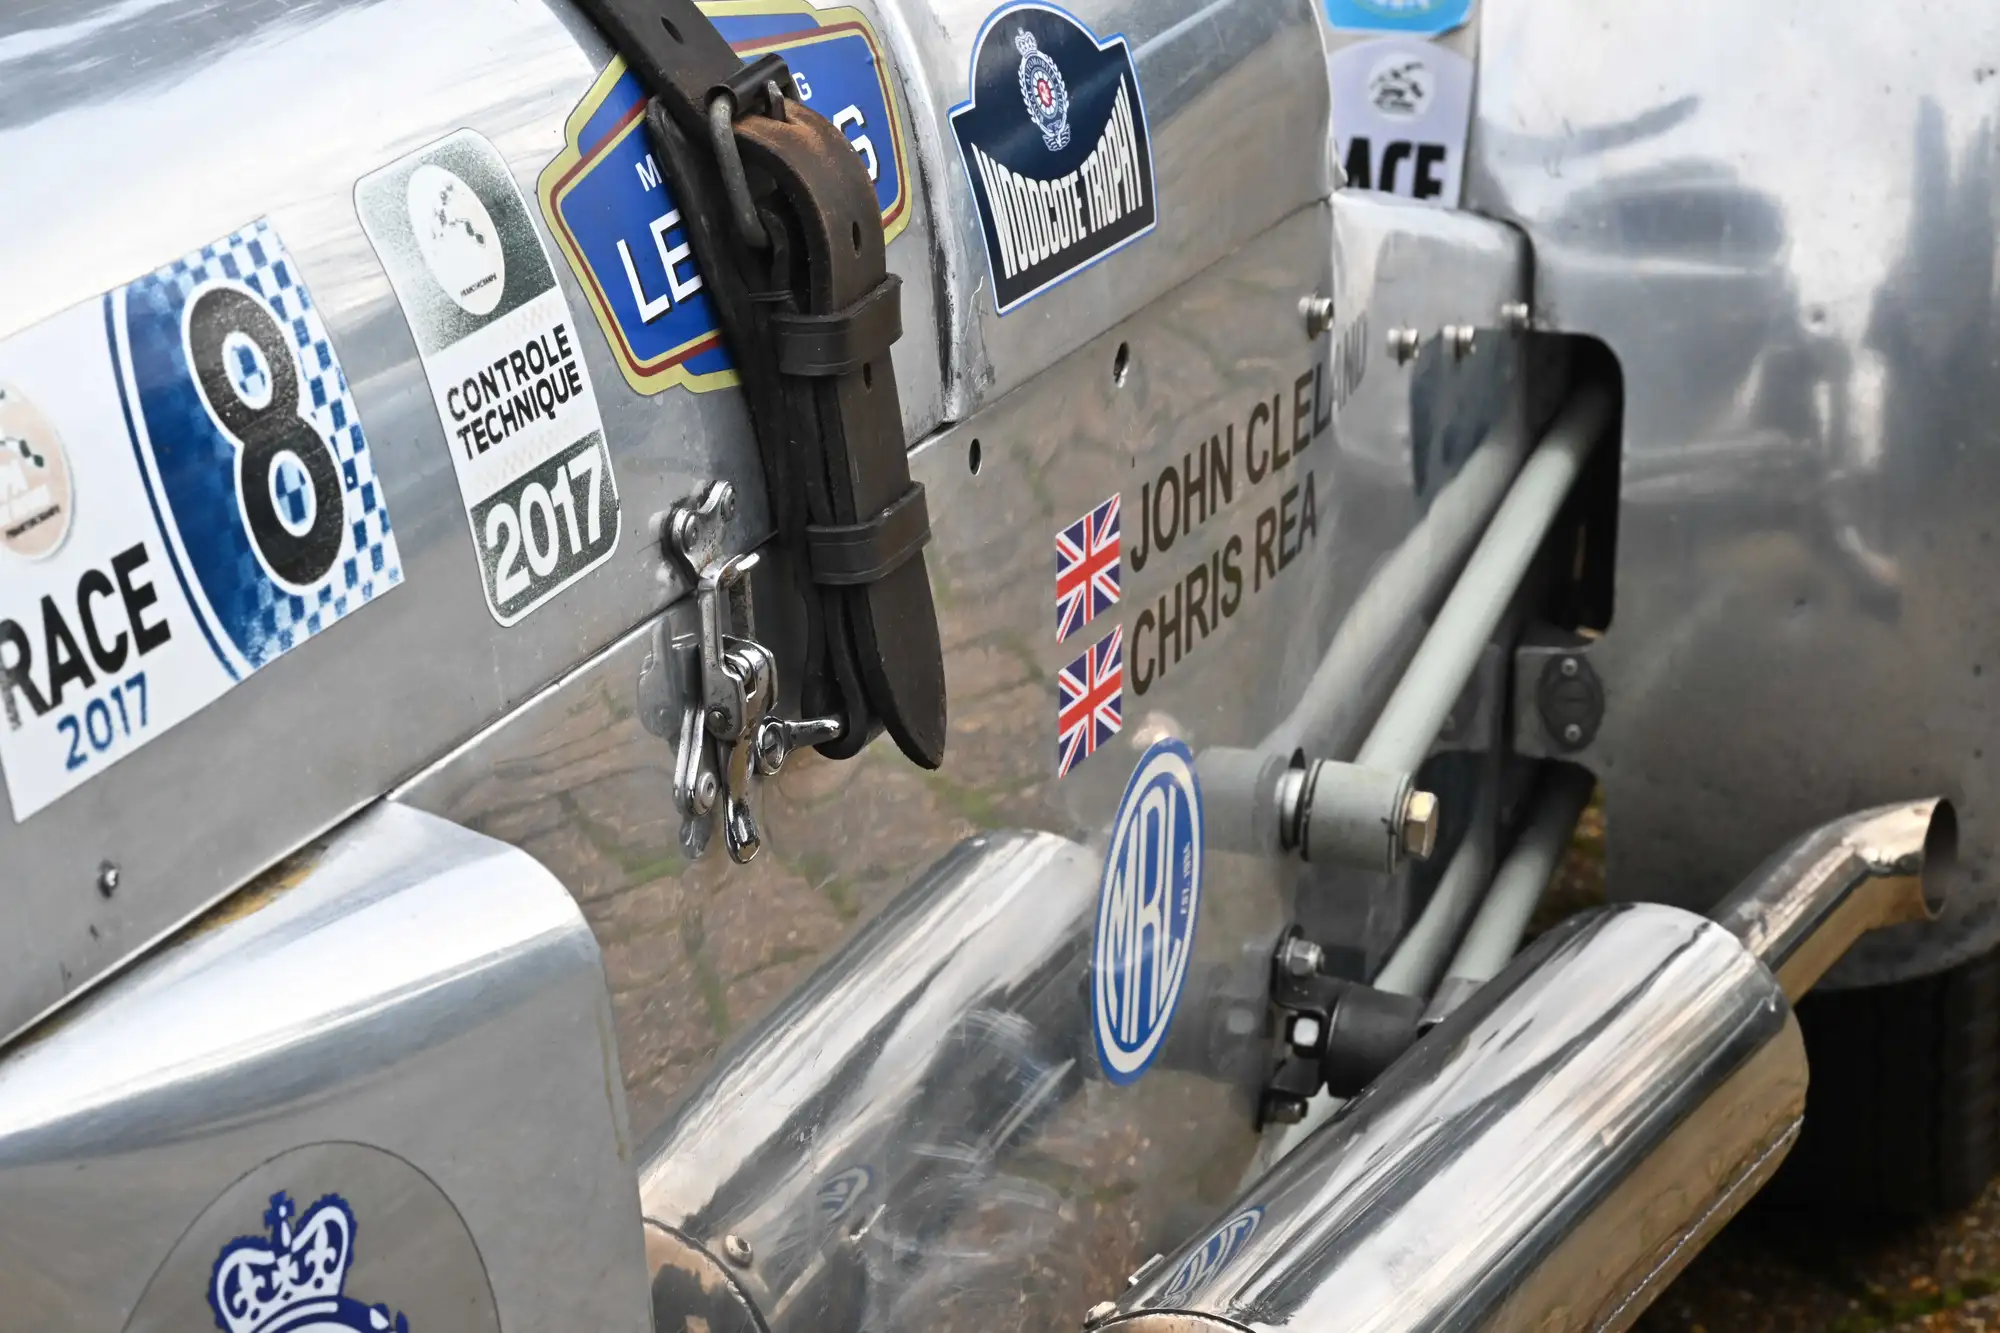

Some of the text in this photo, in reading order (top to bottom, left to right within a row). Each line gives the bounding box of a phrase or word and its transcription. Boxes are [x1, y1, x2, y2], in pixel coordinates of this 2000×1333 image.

[971, 72, 1142, 279] WOODCOTE TROPHY
[187, 285, 345, 588] 8
[446, 323, 572, 423] CONTROLE
[457, 360, 583, 460] TECHNIQUE
[486, 444, 602, 600] 2017
[1130, 424, 1234, 573] JOHN
[1130, 470, 1317, 696] CHRIS REA
[0, 541, 172, 732] RACE
[57, 671, 148, 771] 2017
[1106, 784, 1182, 1045] MRL
